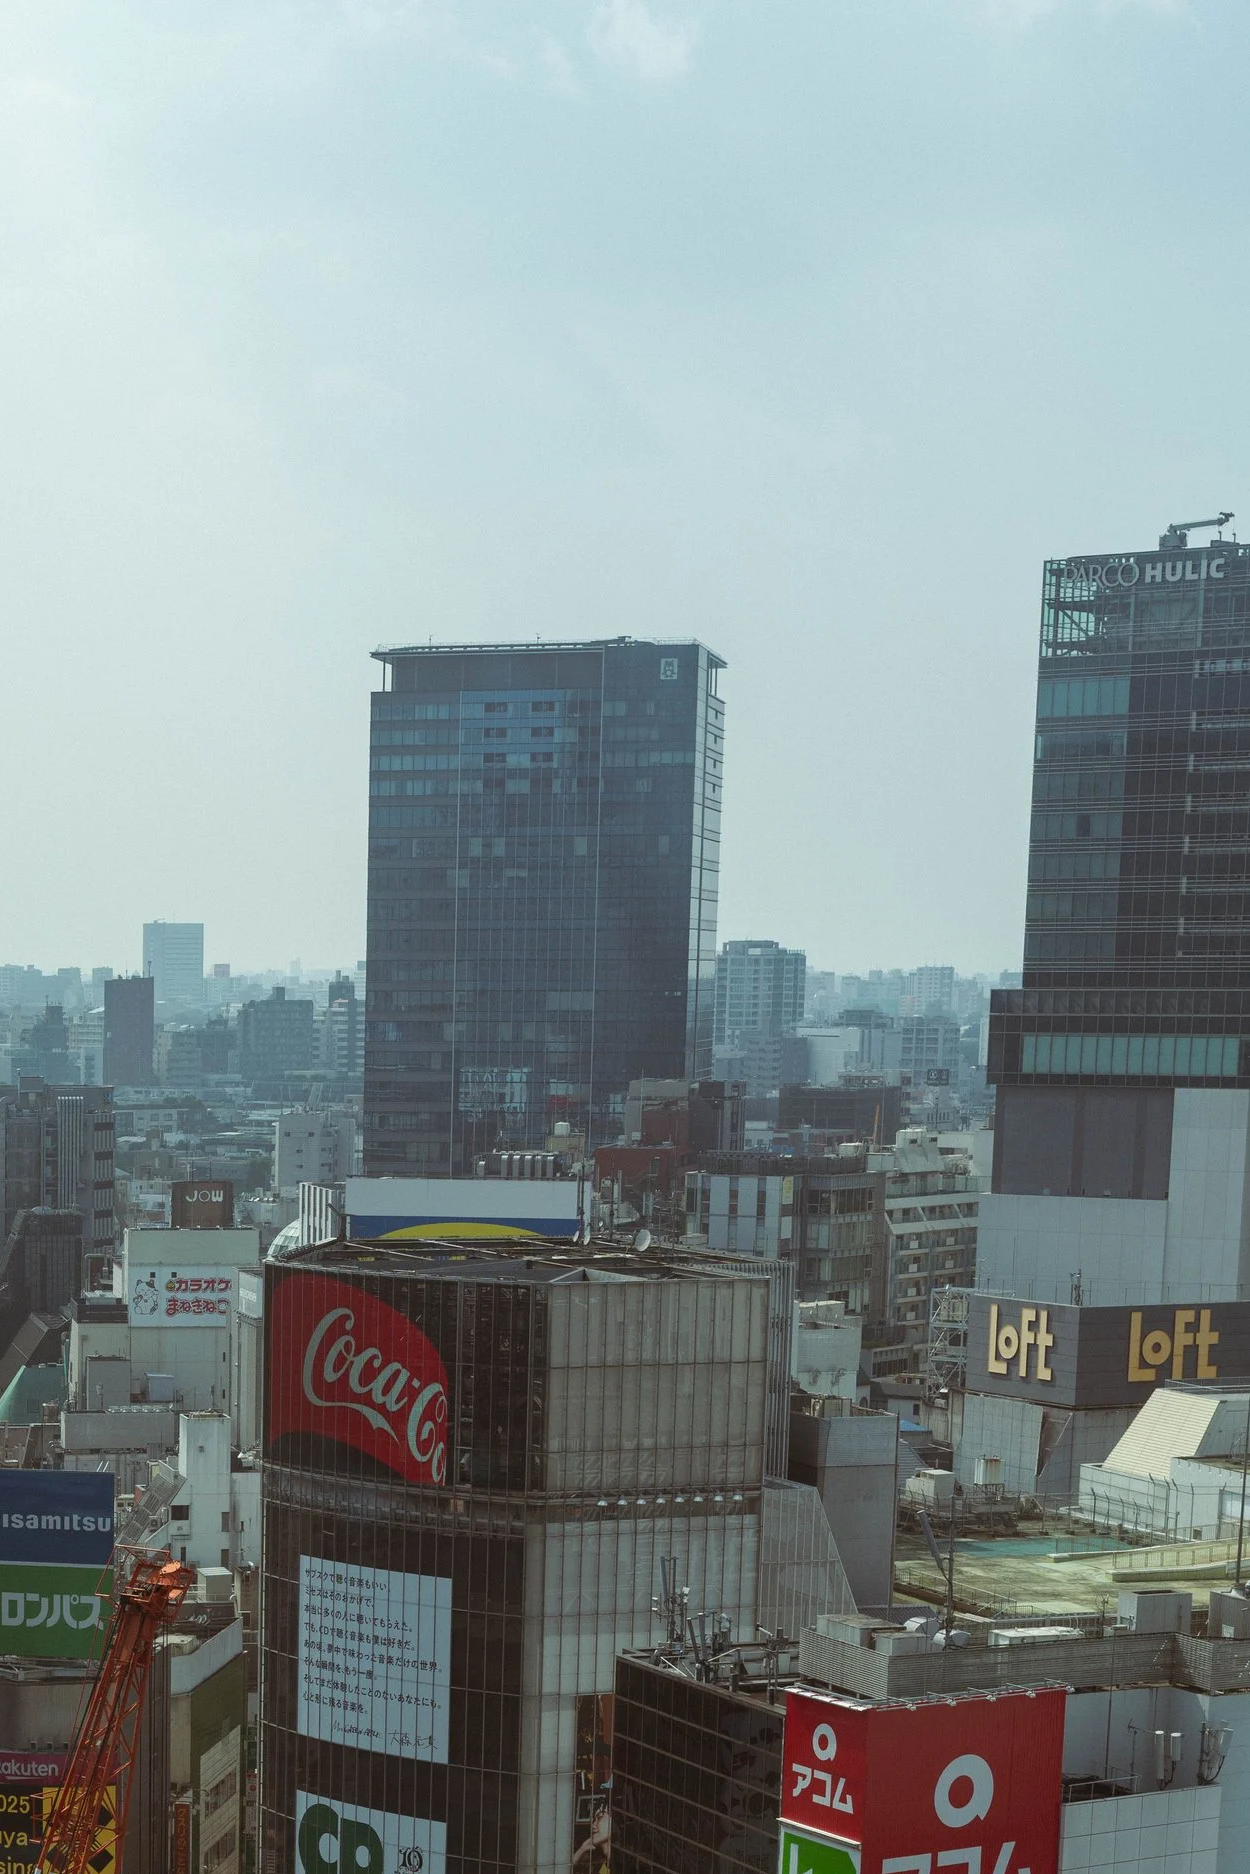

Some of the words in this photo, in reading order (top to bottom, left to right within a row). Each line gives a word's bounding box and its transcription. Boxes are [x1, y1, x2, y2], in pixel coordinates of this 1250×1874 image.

[1063, 562, 1139, 588] PARCO
[1144, 558, 1226, 583] HULIC
[175, 1279, 232, 1293] カラオケ
[165, 1297, 230, 1315] まねきねこ
[791, 1763, 854, 1815] アコム
